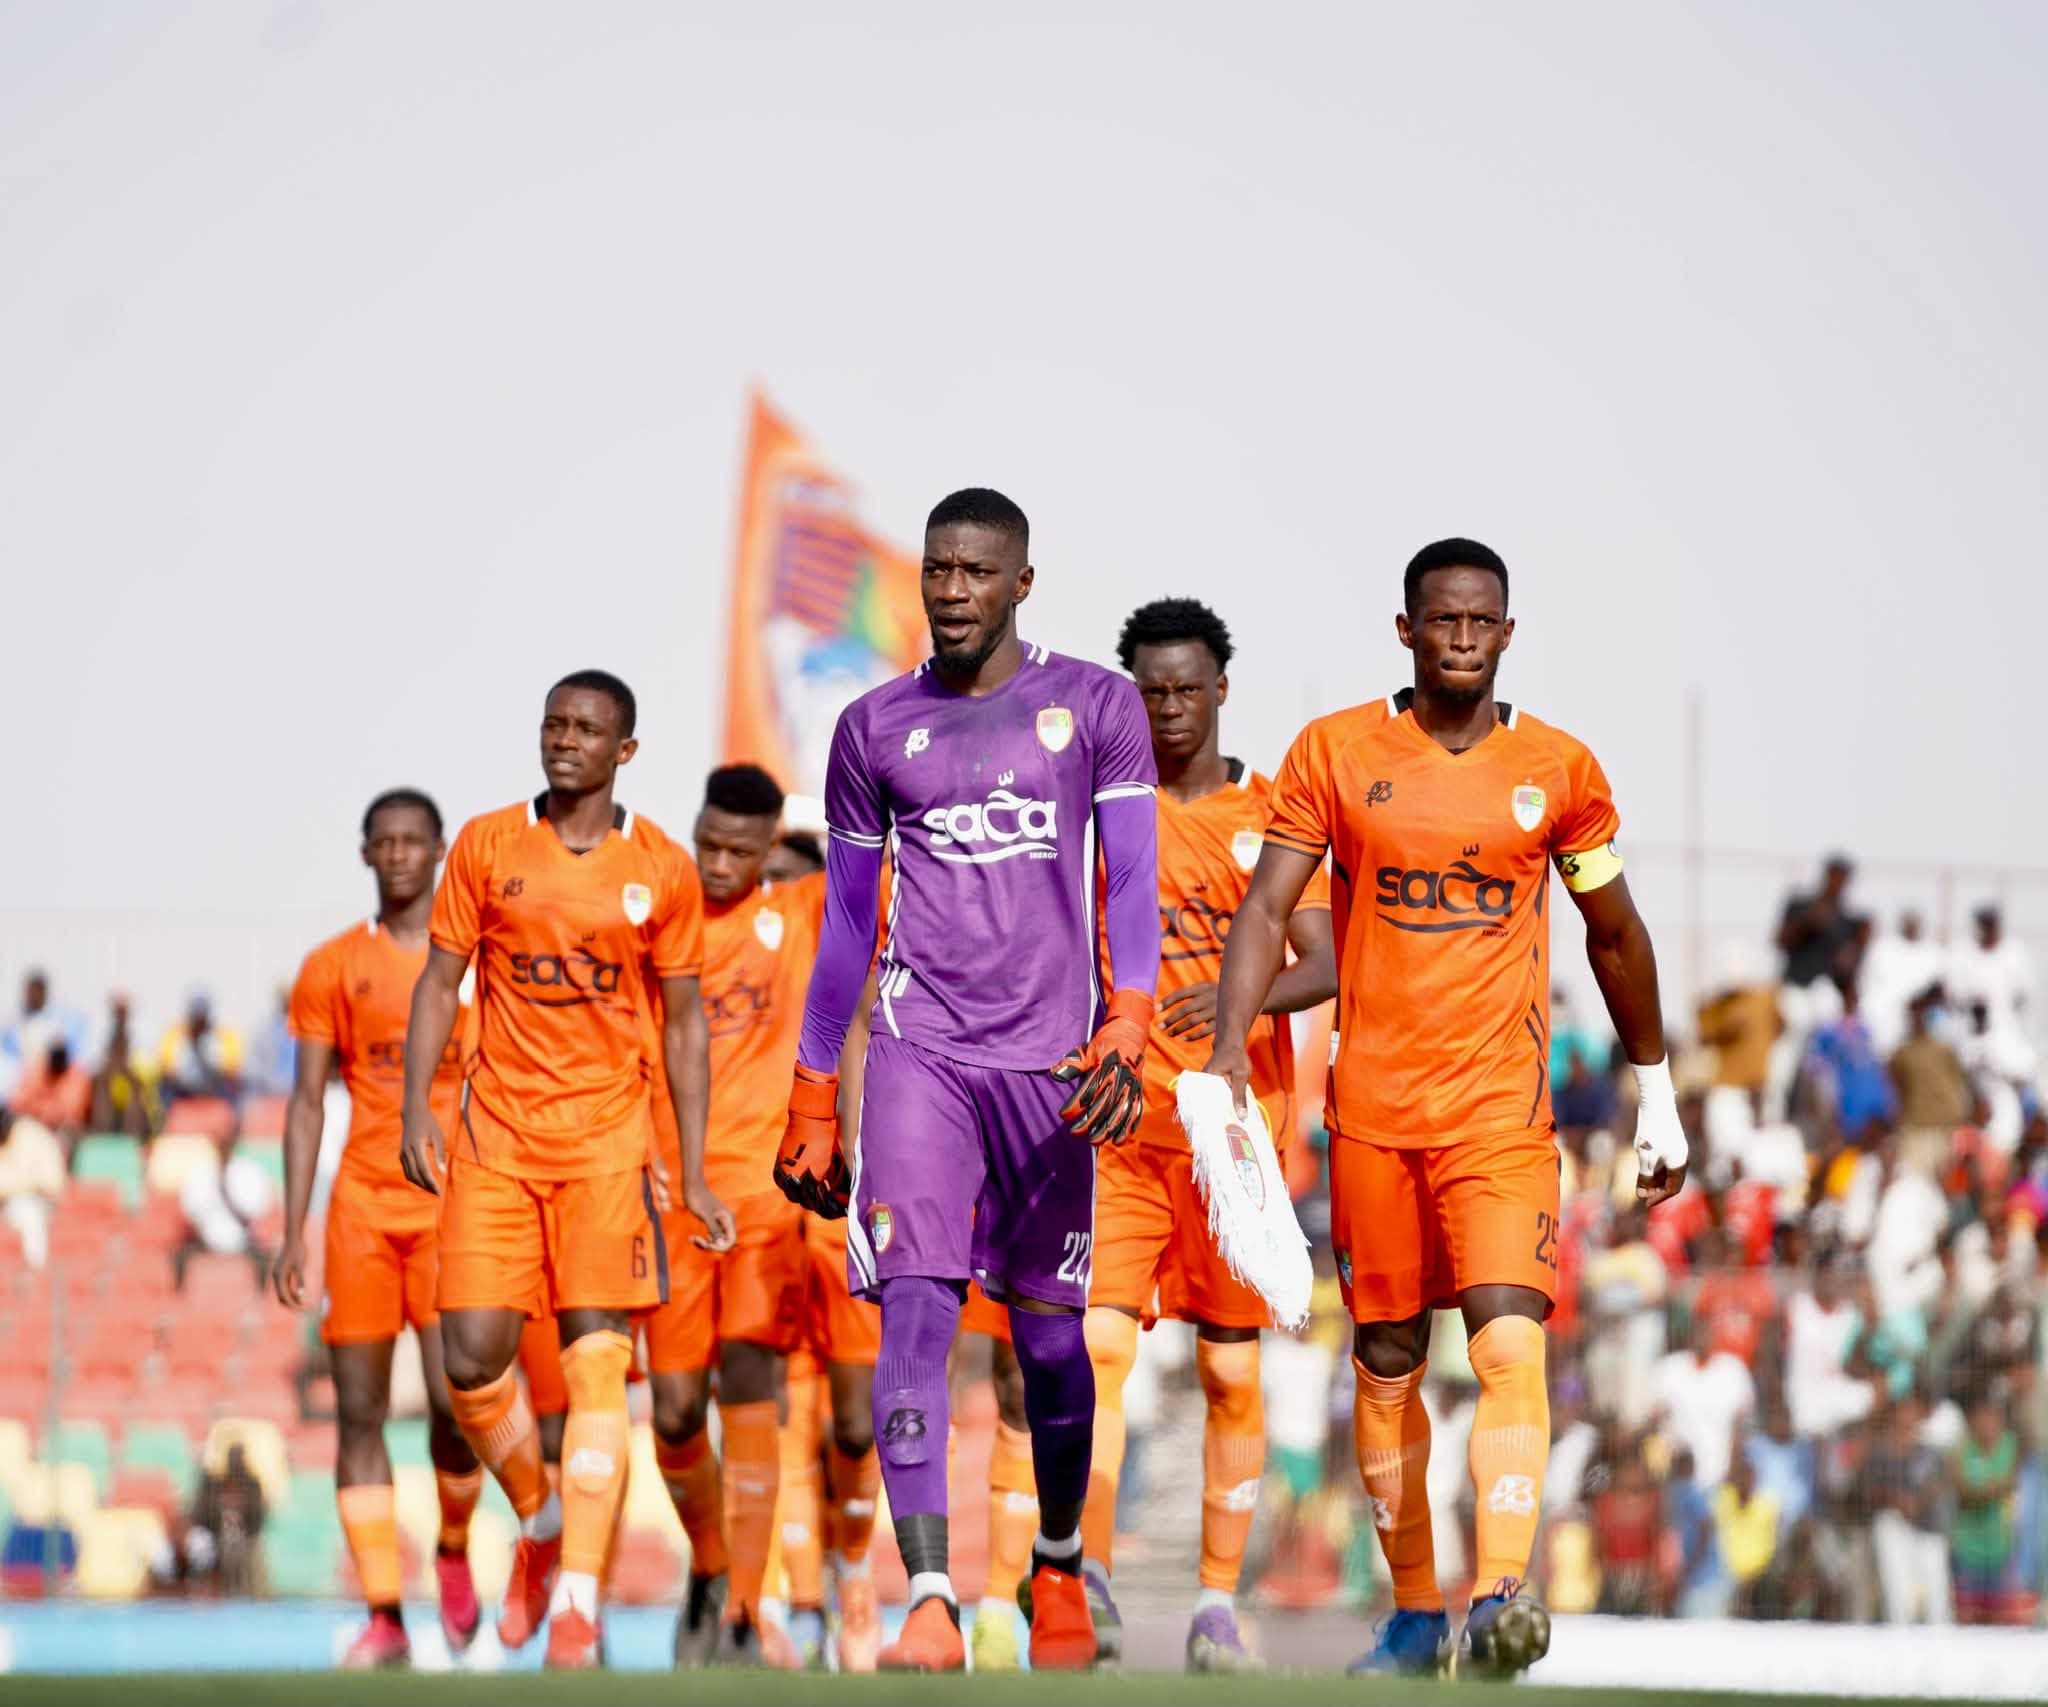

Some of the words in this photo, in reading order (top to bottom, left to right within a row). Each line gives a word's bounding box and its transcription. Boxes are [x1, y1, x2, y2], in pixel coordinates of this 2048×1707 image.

[923, 790, 1058, 845] saca
[1376, 860, 1516, 918] saca
[511, 945, 623, 993] saca
[631, 1236, 647, 1279] 6
